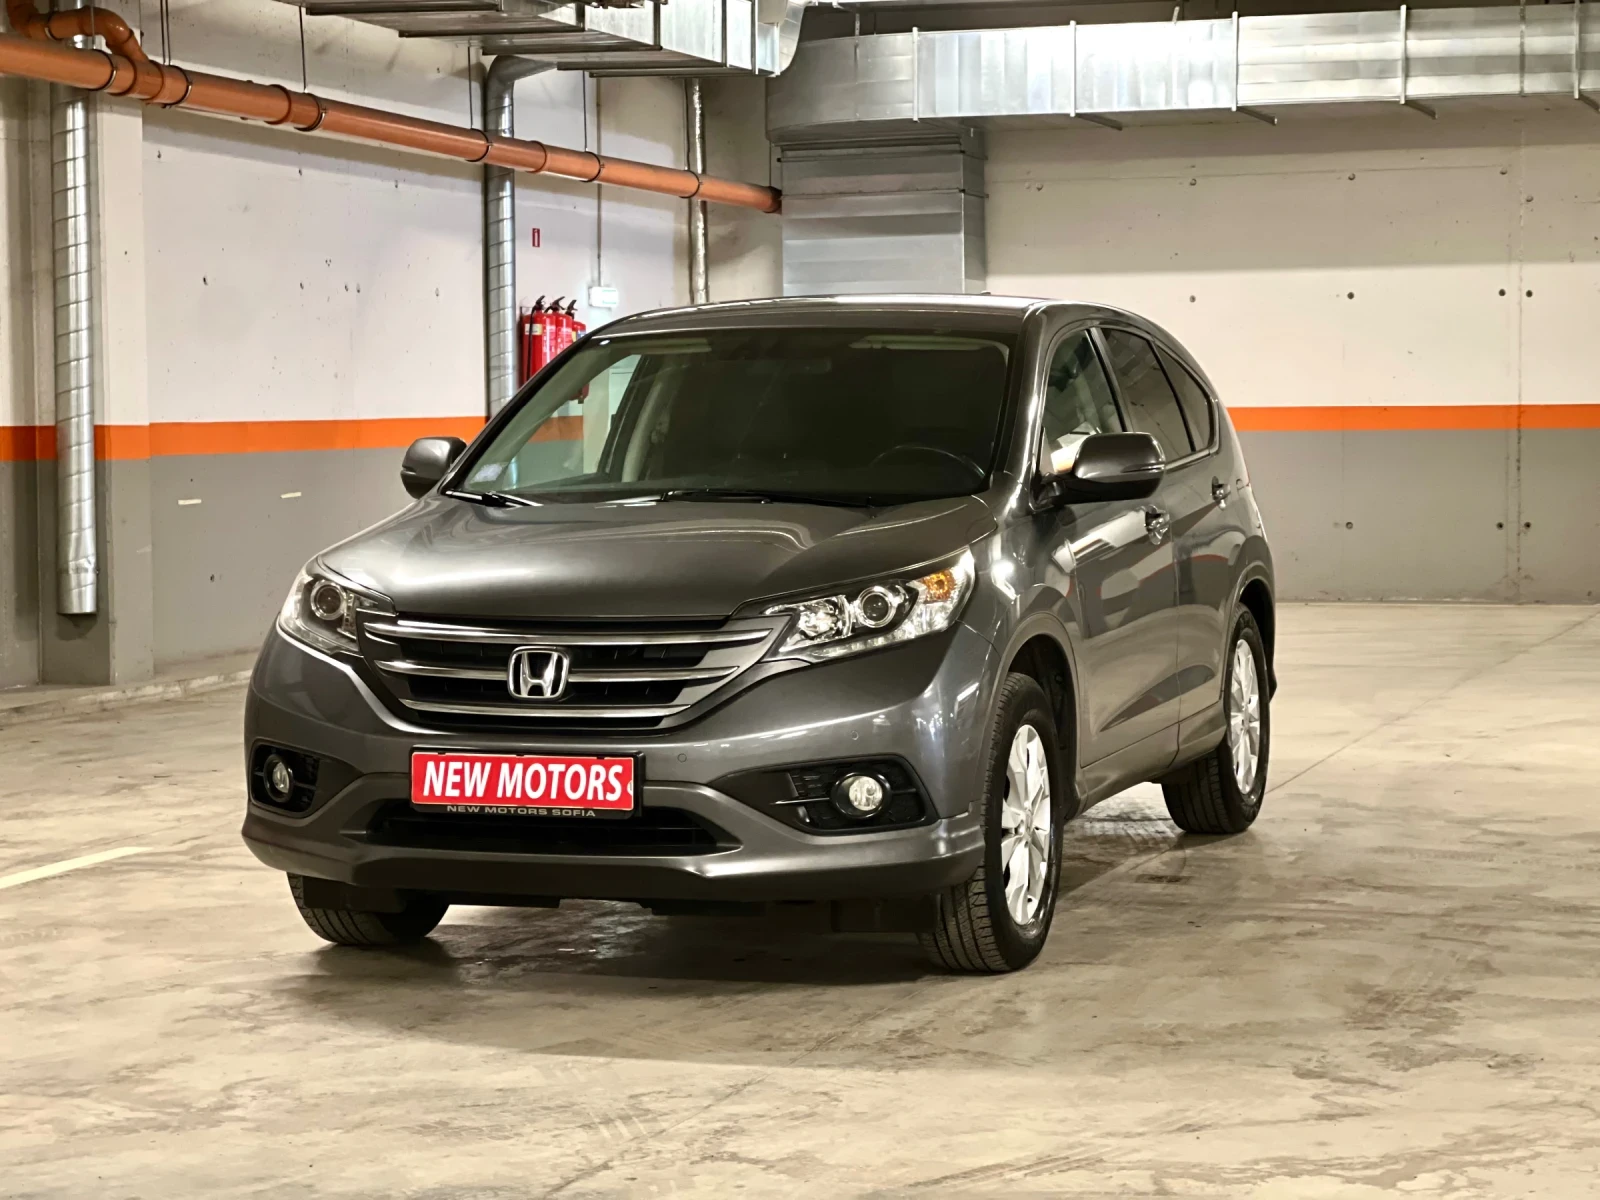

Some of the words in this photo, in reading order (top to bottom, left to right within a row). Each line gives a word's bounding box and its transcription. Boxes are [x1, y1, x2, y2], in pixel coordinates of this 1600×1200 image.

[423, 761, 491, 797] NEW
[496, 762, 623, 802] MOTORS
[447, 805, 480, 813] NEW
[484, 806, 548, 816] MOTORS
[552, 808, 596, 817] SOFIA
